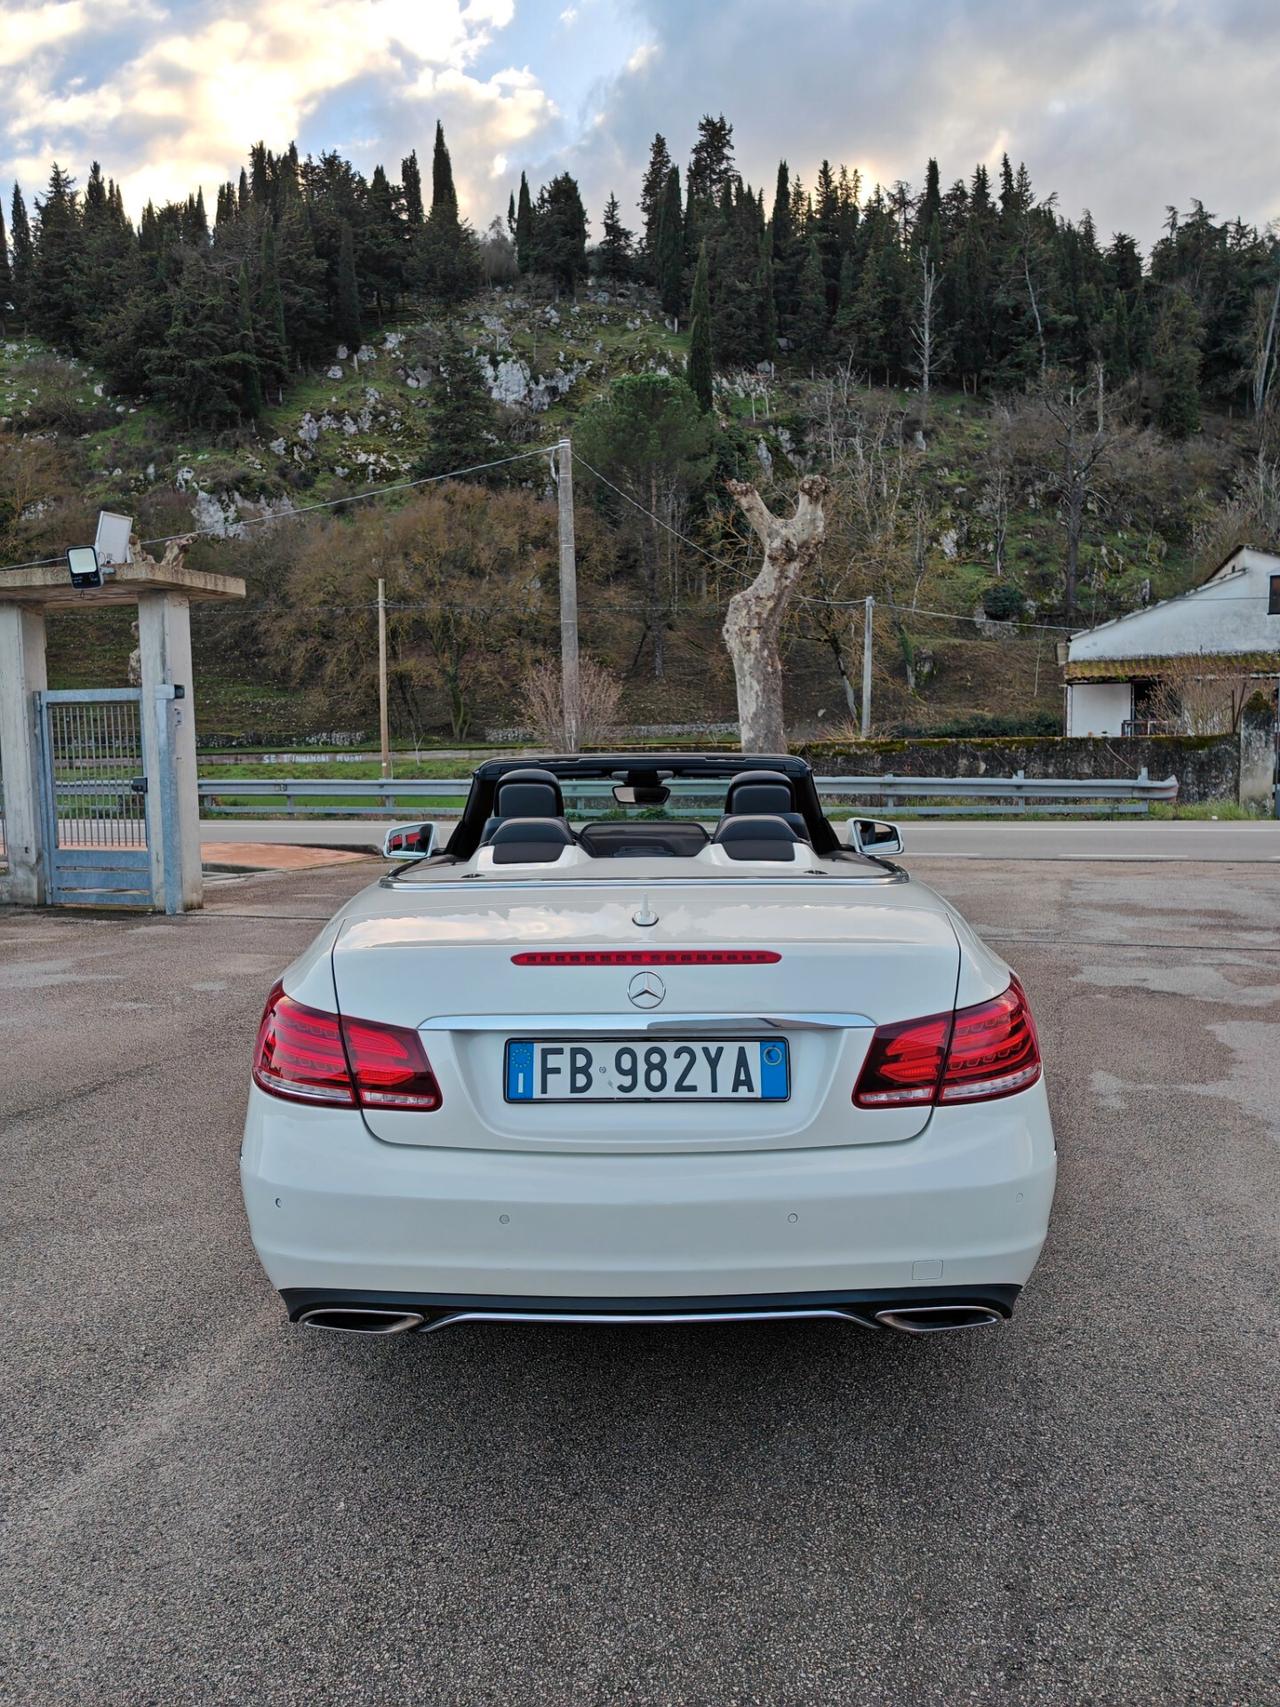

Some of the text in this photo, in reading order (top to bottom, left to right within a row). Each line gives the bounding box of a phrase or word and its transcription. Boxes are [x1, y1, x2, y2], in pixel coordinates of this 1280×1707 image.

[263, 754, 276, 764] SE
[540, 1046, 755, 1094] FB 982YA
[517, 1072, 524, 1093] I
